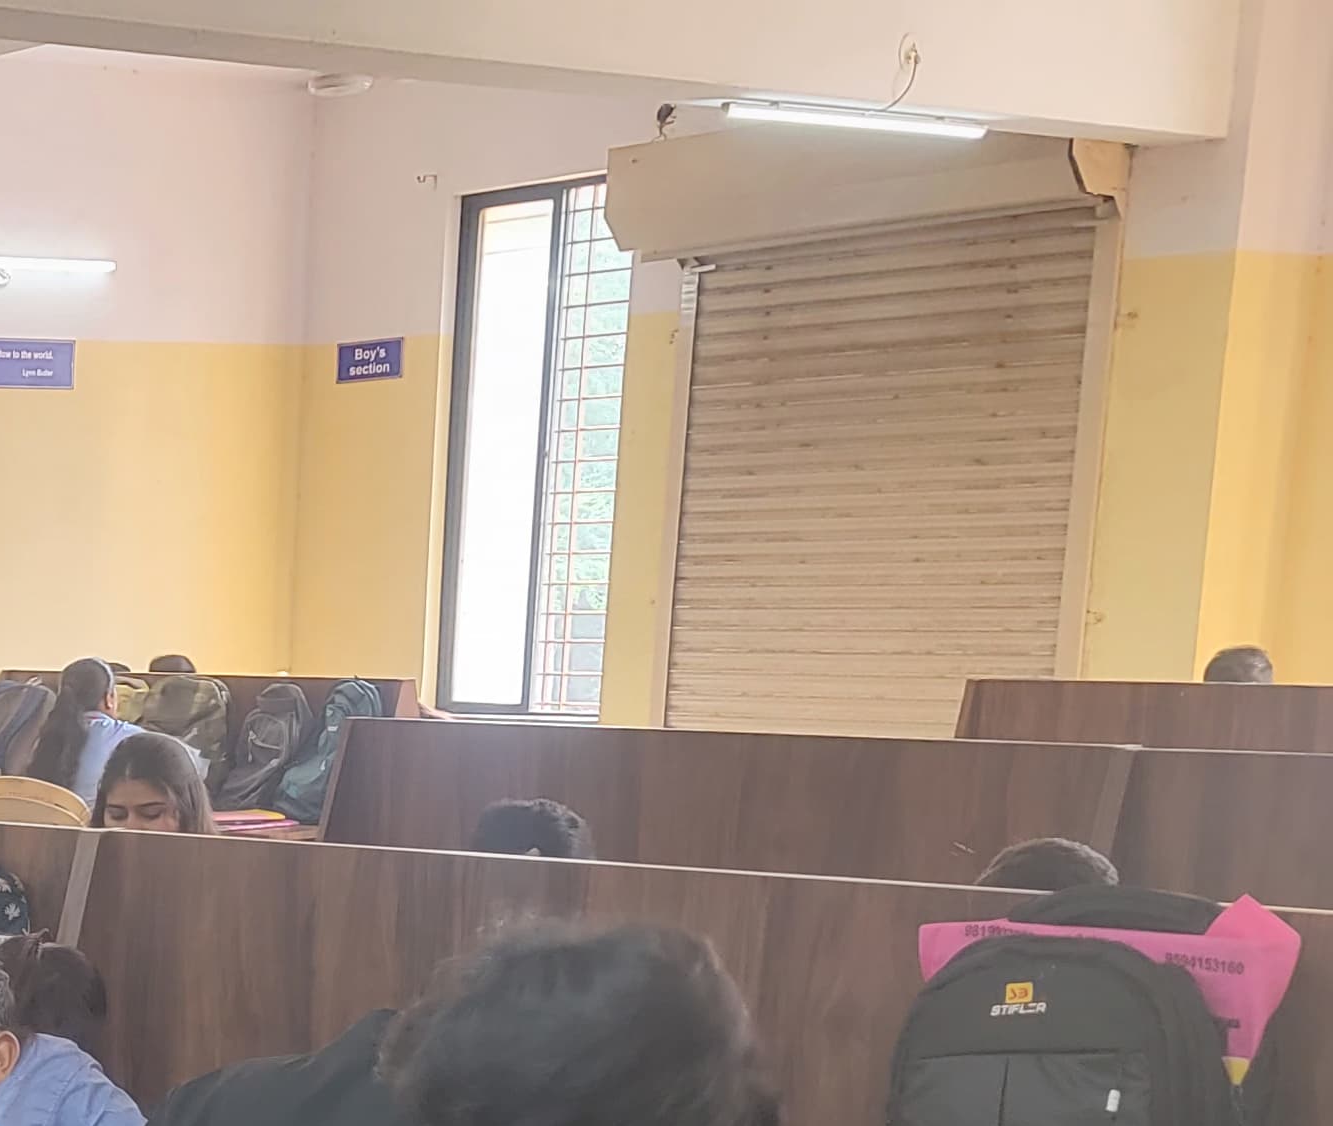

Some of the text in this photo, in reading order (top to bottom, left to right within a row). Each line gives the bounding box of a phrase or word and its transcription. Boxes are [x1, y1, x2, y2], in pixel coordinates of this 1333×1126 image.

[13, 350, 19, 359] to
[21, 350, 31, 359] the
[354, 346, 386, 361] Boy's
[349, 362, 390, 376] section
[990, 1002, 1047, 1016] STIFLER
